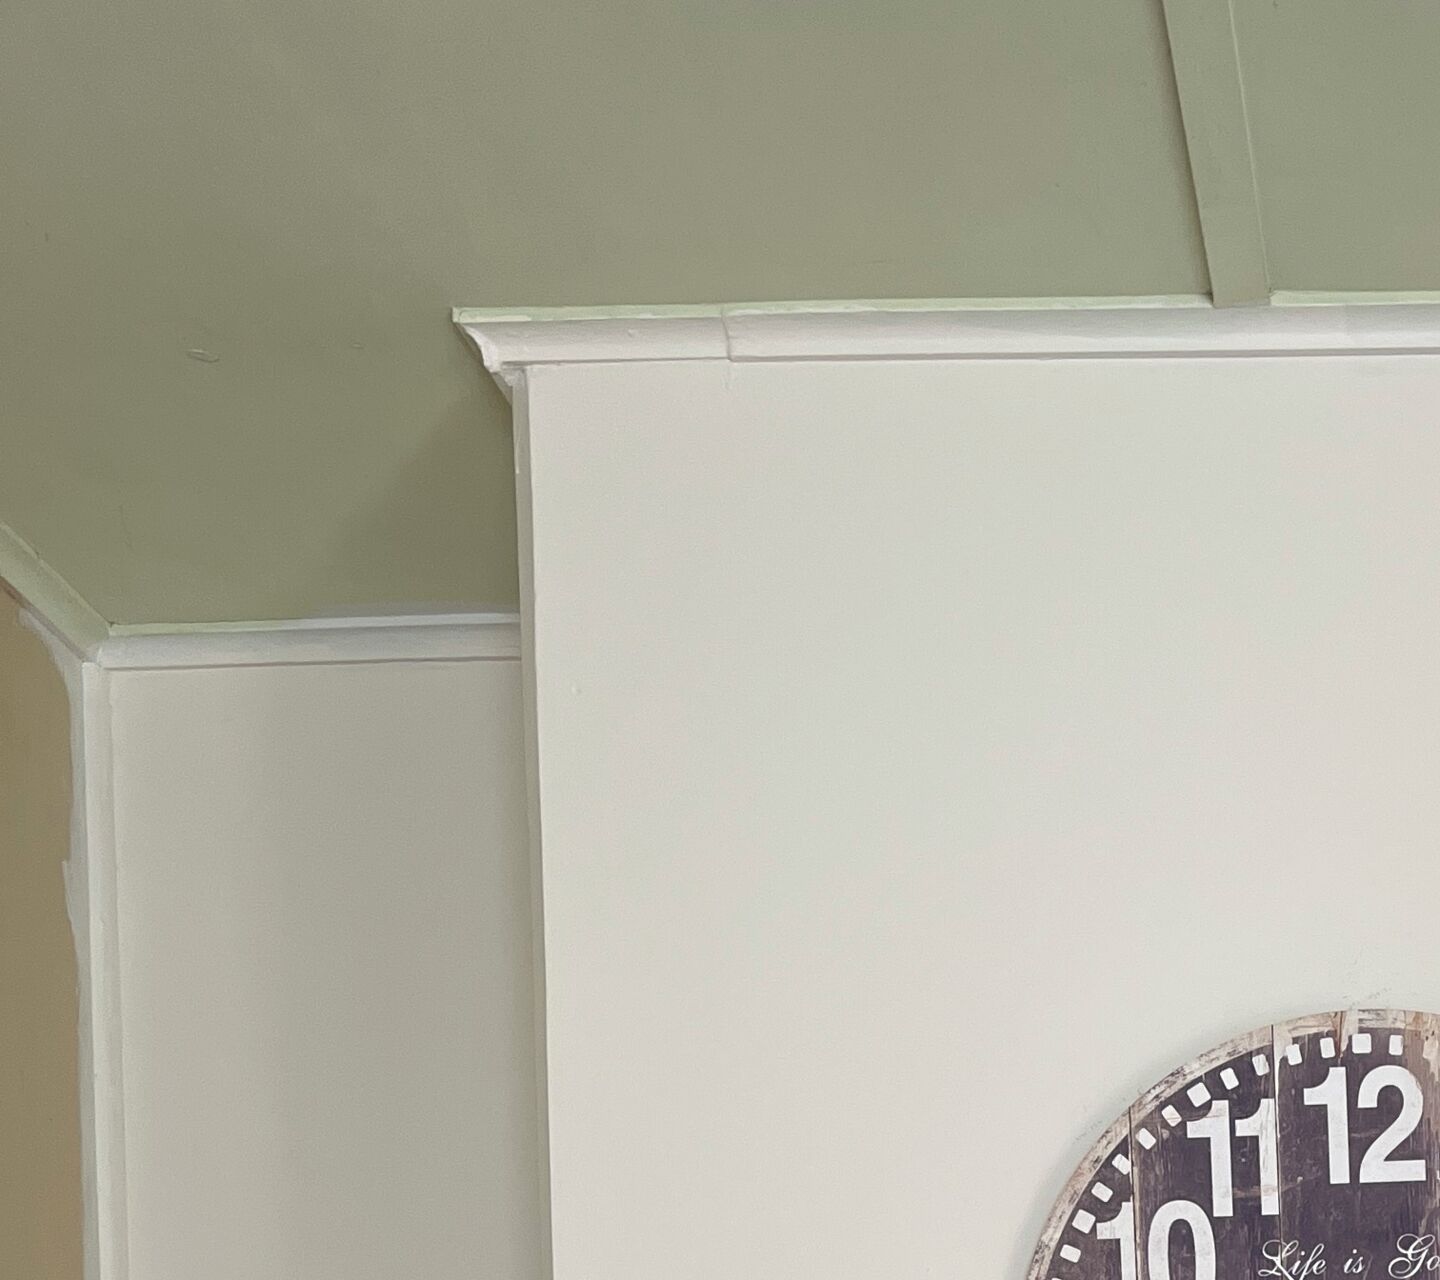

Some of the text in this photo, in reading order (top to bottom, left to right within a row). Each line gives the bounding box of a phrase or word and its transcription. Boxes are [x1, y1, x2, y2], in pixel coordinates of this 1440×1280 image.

[1186, 1098, 1280, 1218] 11
[1303, 1065, 1426, 1185] 12
[1343, 1248, 1365, 1275] is
